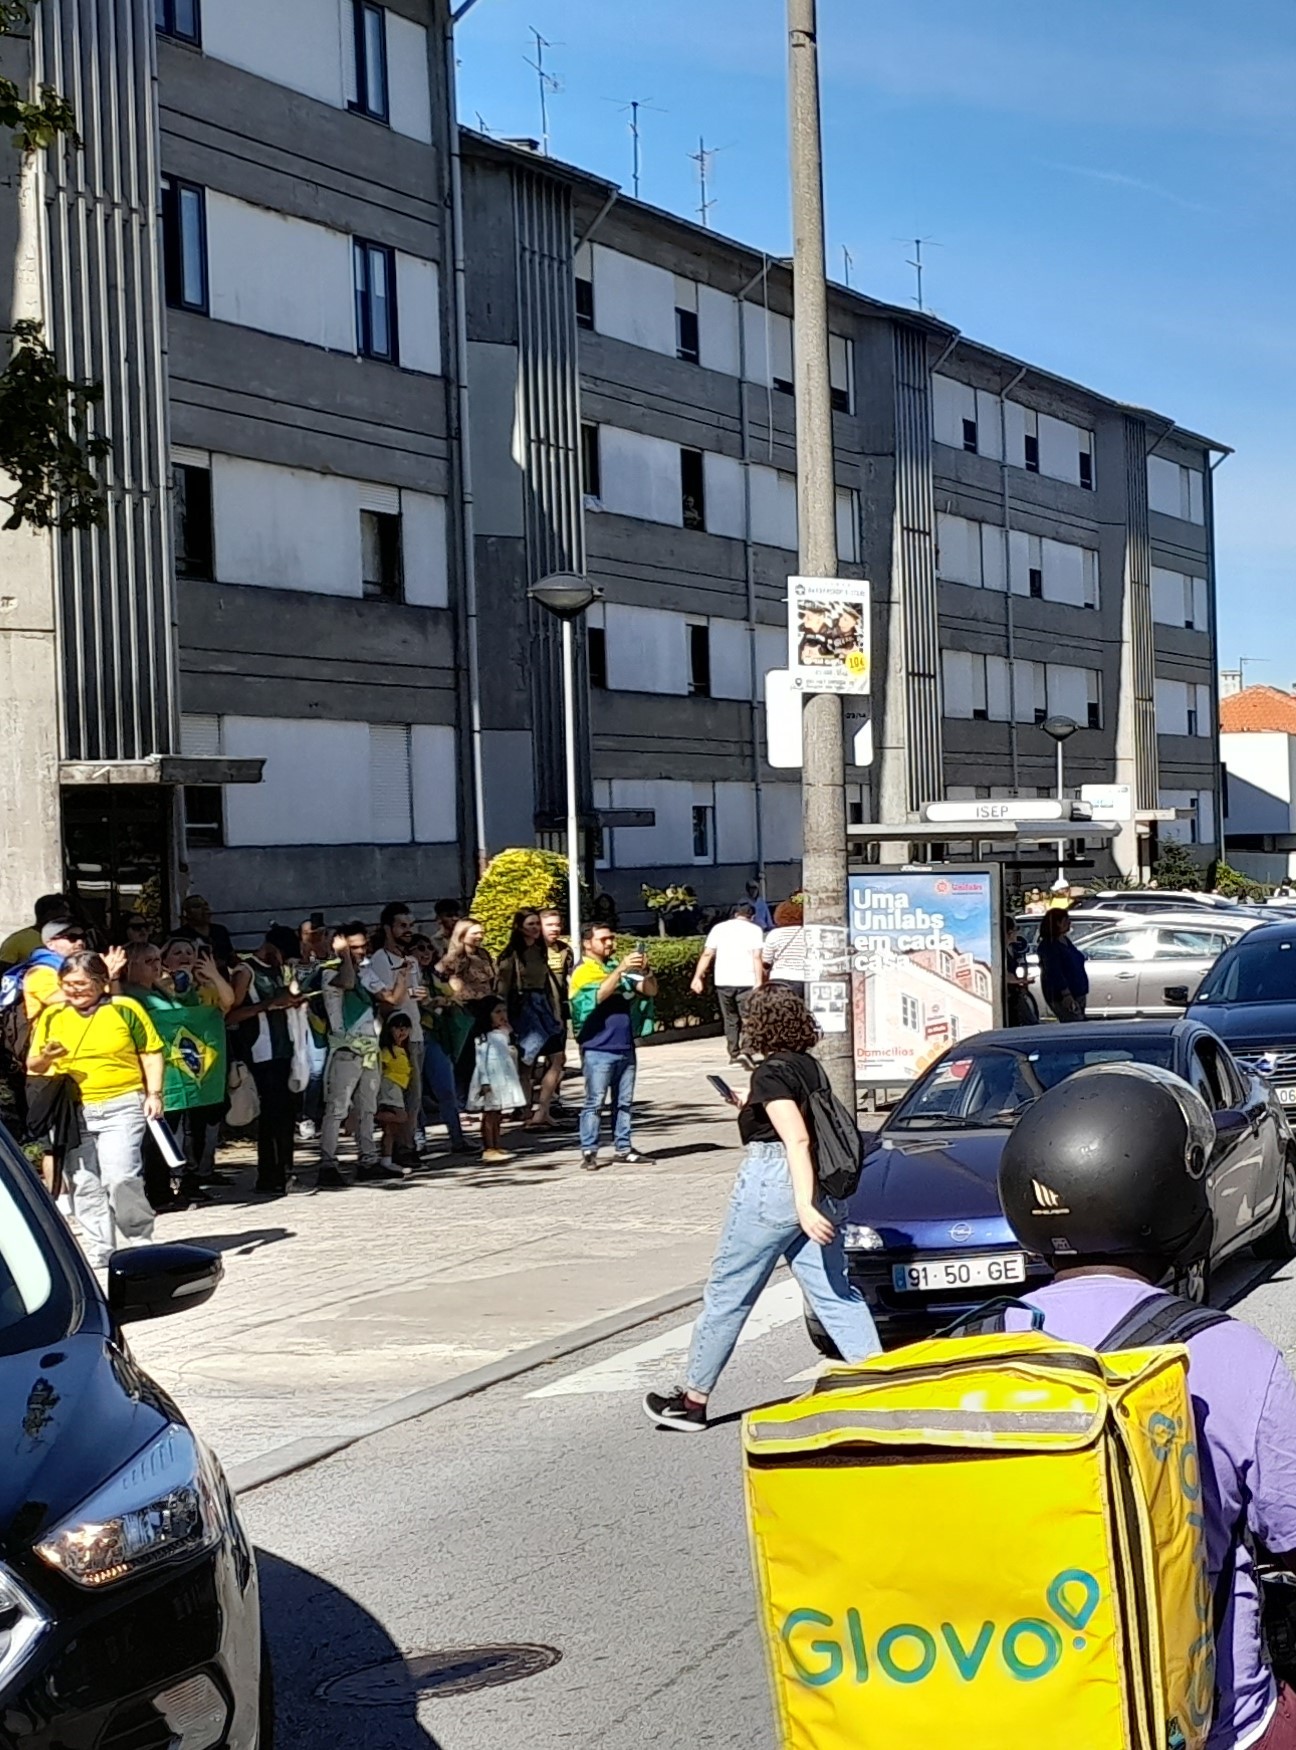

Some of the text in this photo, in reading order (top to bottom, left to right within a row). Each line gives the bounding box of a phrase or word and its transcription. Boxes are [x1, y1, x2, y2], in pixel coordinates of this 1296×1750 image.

[975, 806, 1009, 818] ISEP
[853, 888, 909, 910] Uma
[853, 907, 945, 931] Unilabs
[854, 928, 955, 952] em cada
[854, 954, 911, 972] casa
